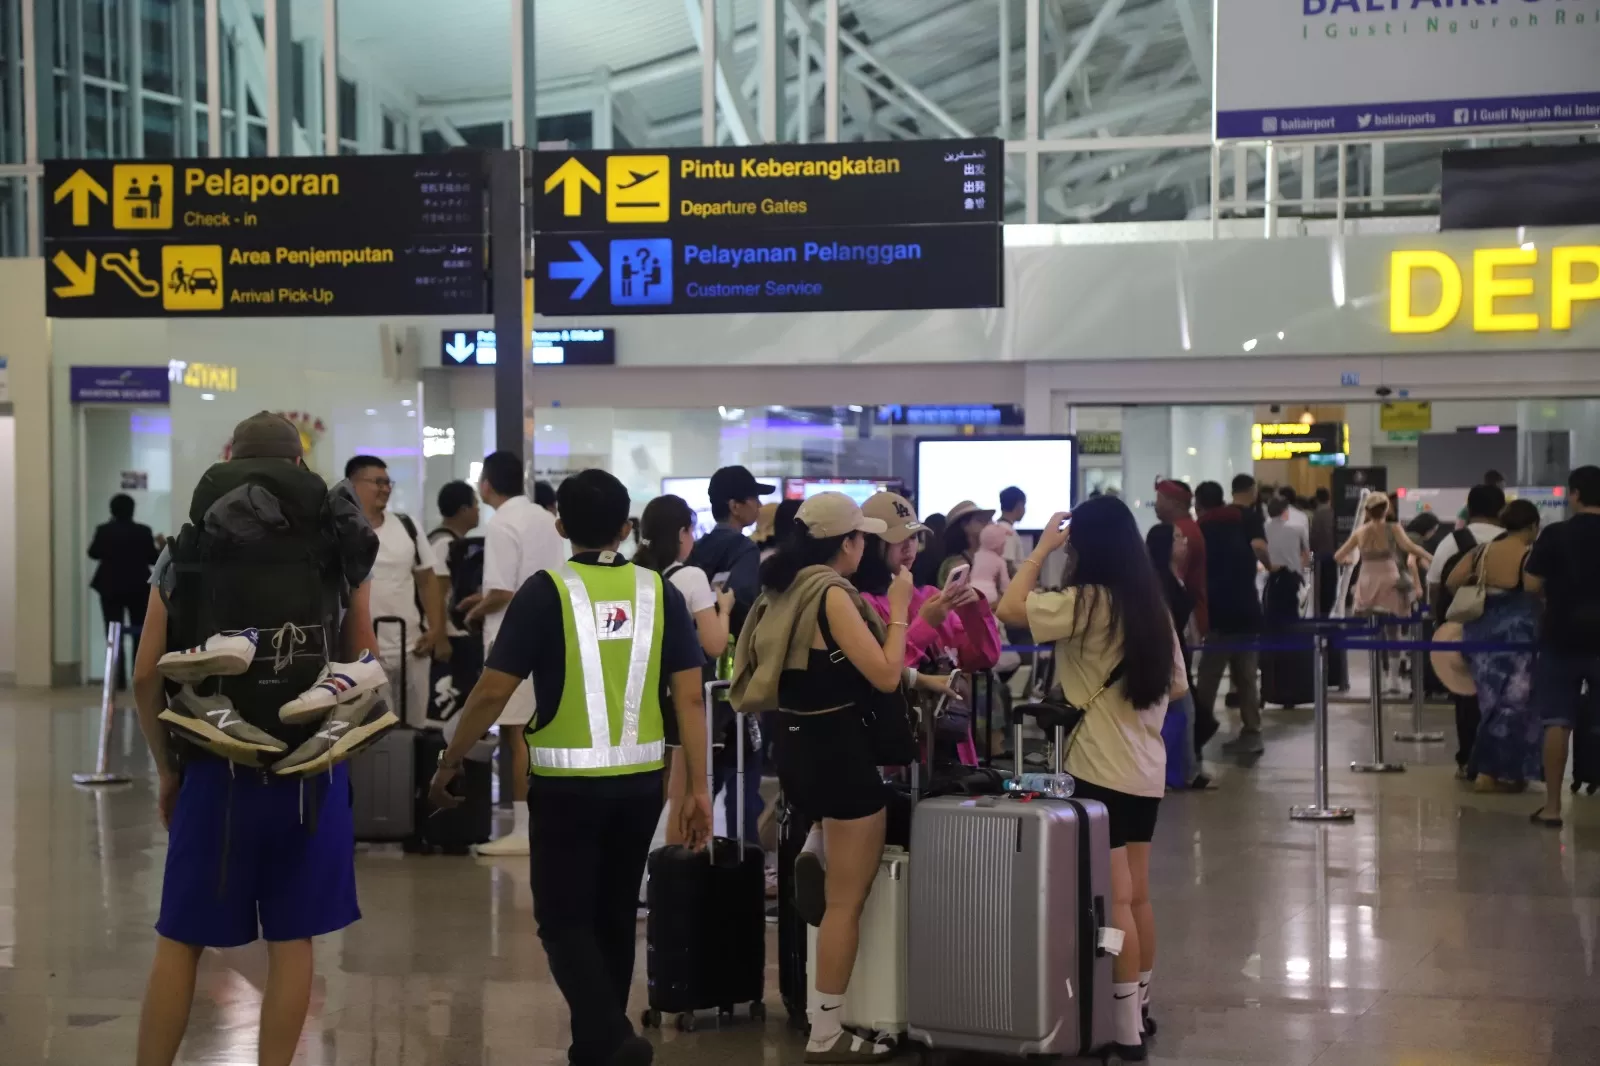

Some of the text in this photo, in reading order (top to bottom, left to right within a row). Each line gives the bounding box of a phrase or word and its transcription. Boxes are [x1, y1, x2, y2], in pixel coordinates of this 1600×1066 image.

[1325, 21, 1408, 38] Gusti
[1427, 12, 1538, 34] Ngurah
[1375, 112, 1436, 127] baliairports
[1480, 108, 1508, 121] Gusti
[1511, 105, 1551, 122] Ngurah
[1554, 104, 1572, 117] Rai
[1281, 117, 1335, 131] baliairport
[680, 156, 900, 180] Pintu Keberangkatan
[184, 168, 340, 203] Pelaporan
[681, 198, 808, 218] Departure Gates
[184, 211, 231, 227] Check
[244, 211, 258, 226] in
[229, 246, 394, 268] Area Penjemputan
[684, 241, 922, 269] Pelayanan Pelanggan
[230, 287, 334, 305] Arrival Pick-Up
[685, 279, 823, 298] Customer Service
[1389, 245, 1600, 334] DEP
[892, 501, 911, 518] LA
